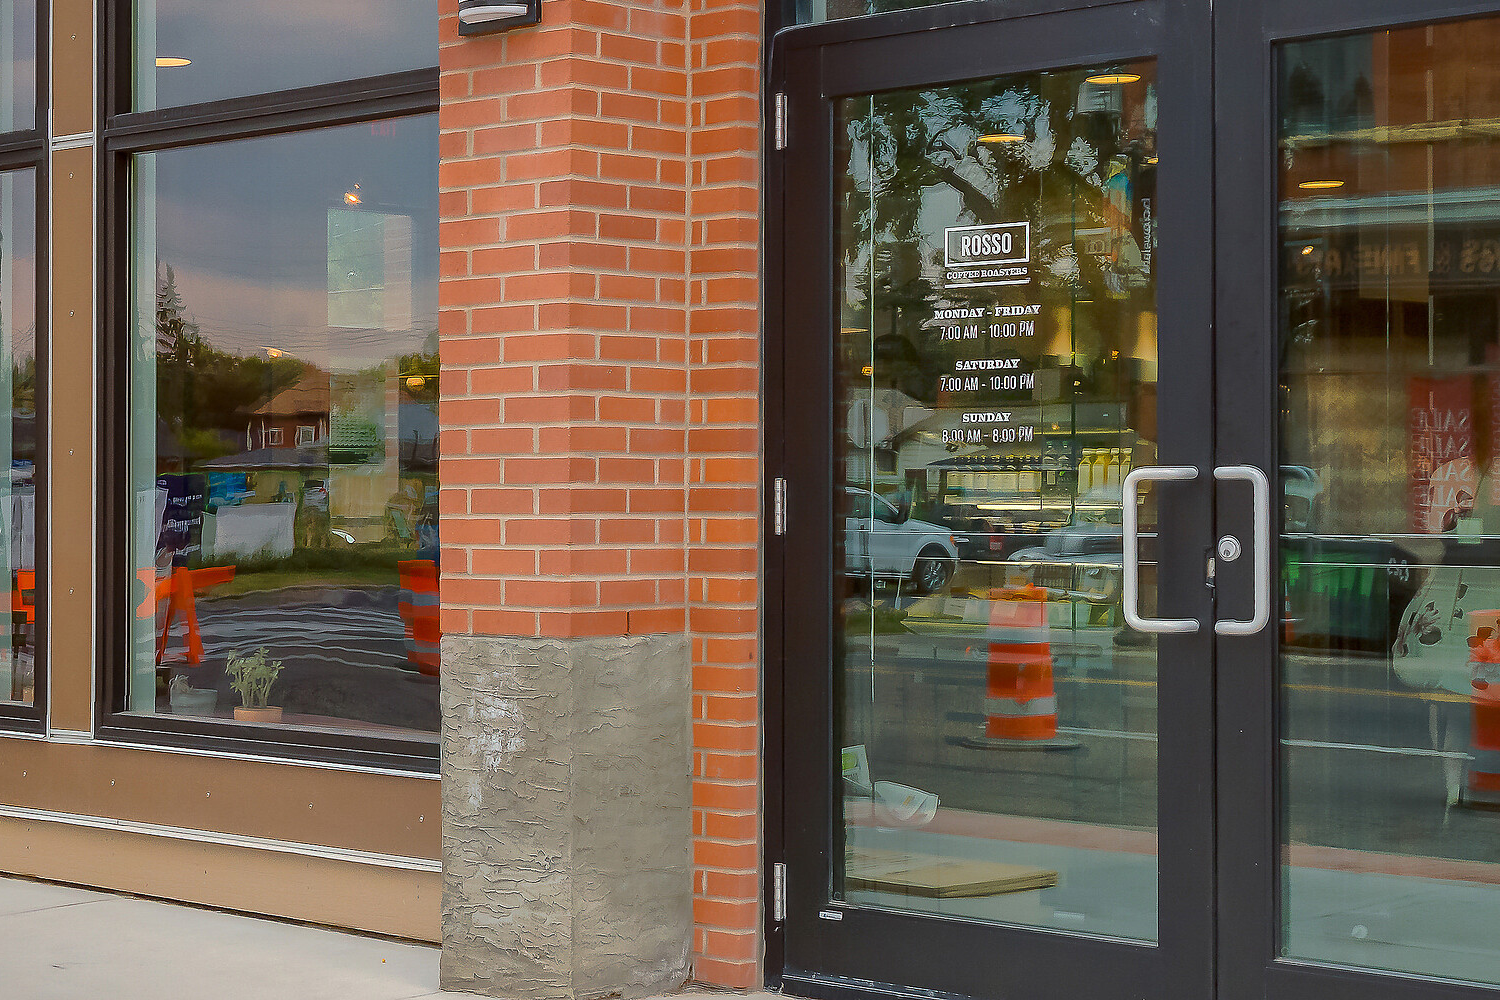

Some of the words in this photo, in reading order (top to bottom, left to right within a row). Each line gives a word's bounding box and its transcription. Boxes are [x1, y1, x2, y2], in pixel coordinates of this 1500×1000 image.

[961, 232, 1012, 257] ROSSO
[946, 269, 980, 280] COFFEE
[981, 267, 1028, 278] ROASTERS
[933, 307, 986, 320] MONDAY
[994, 304, 1042, 317] FRIDAY
[940, 326, 961, 340] 7:00
[963, 325, 978, 339] AM
[989, 323, 1016, 338] 10:00
[1019, 320, 1035, 337] PM
[955, 358, 1021, 371] SATURDAY
[940, 377, 962, 391] 7:00
[963, 377, 979, 391] AM
[990, 375, 1017, 390] 10:00
[1019, 373, 1035, 389] PM
[962, 412, 1012, 423] SUNDAY
[942, 429, 964, 443] 8:00
[966, 429, 981, 443] AM
[992, 428, 1016, 443] 8:00
[1018, 426, 1034, 442] PM
